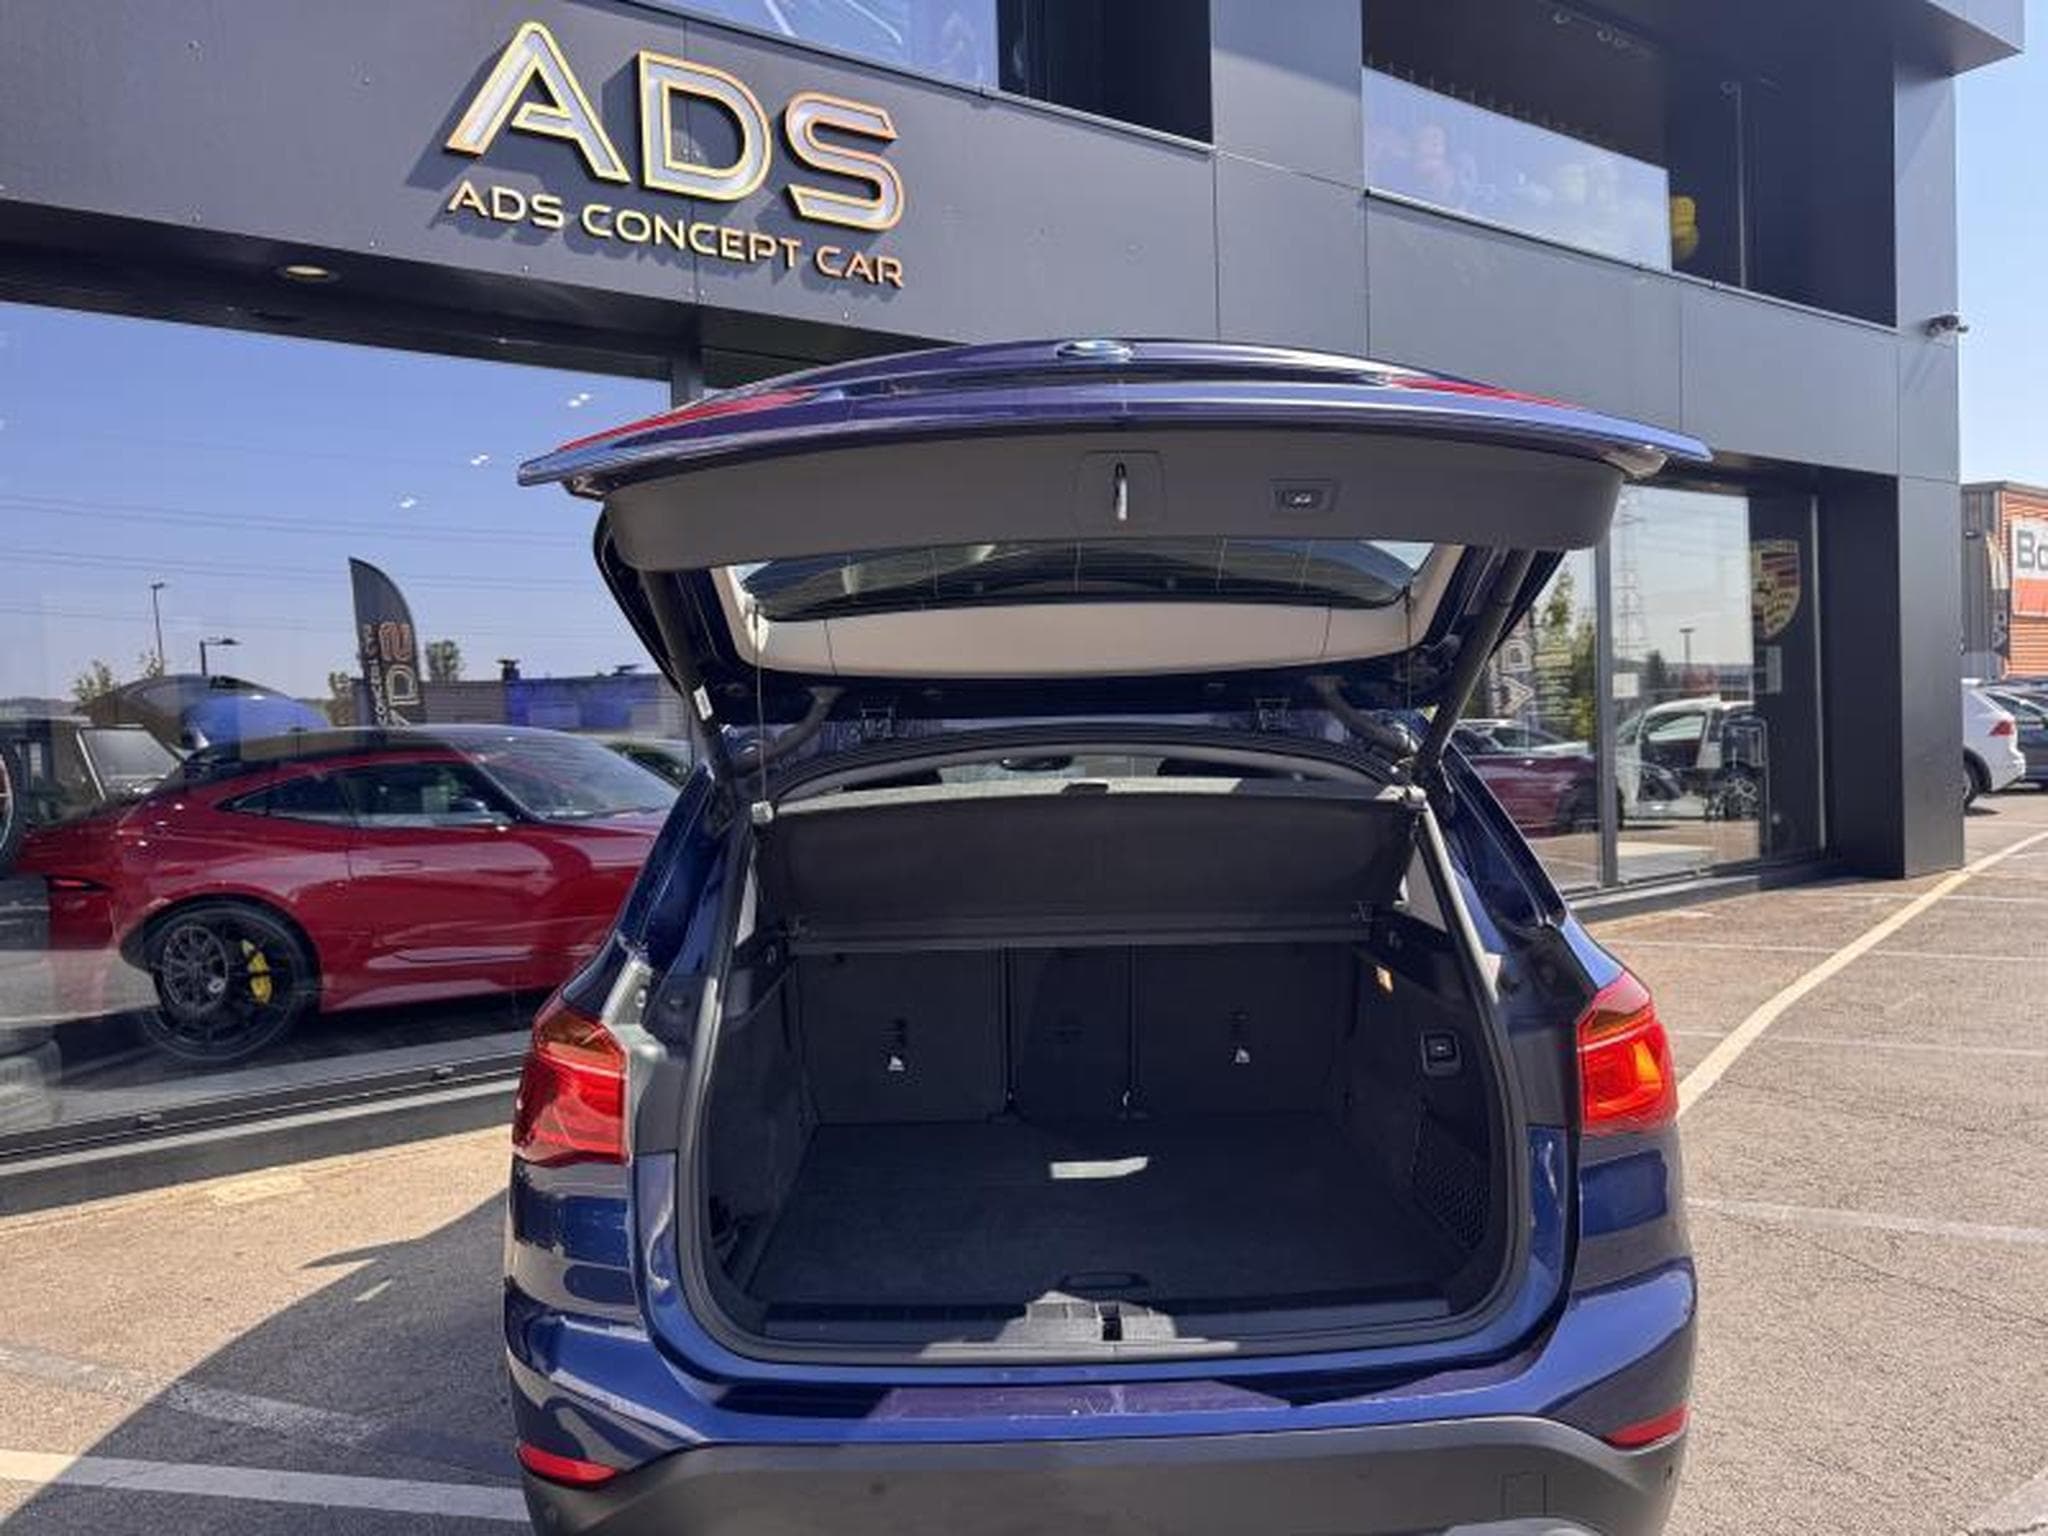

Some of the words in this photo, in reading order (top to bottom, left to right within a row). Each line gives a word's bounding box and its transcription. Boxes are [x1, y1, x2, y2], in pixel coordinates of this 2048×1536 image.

[445, 21, 905, 231] ADS
[448, 181, 565, 231] ADS
[582, 204, 803, 269] CONCEPT
[815, 246, 905, 288] CAR
